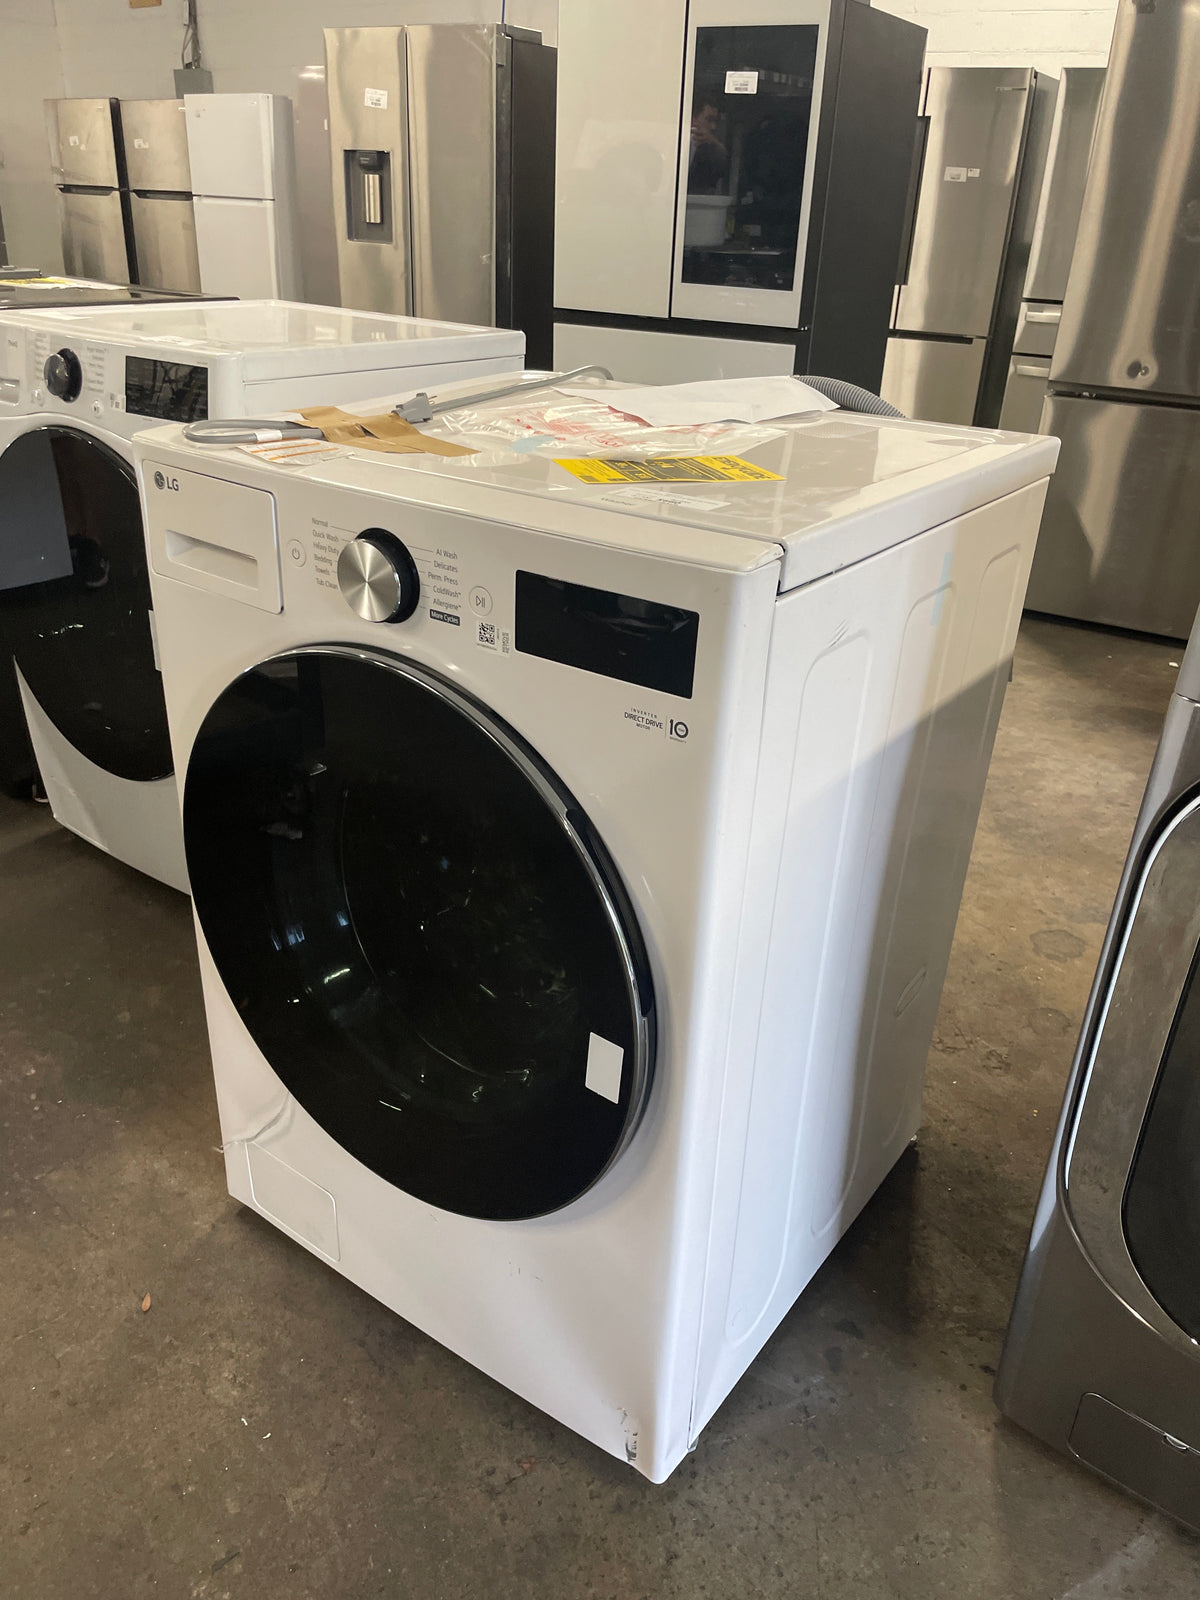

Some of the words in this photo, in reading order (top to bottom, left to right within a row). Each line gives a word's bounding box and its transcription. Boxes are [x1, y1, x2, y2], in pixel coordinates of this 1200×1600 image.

[167, 476, 179, 491] LG
[311, 517, 328, 527] Normal
[312, 529, 325, 539] Quick
[326, 533, 339, 542] Wash
[313, 542, 327, 553] Heavy
[328, 545, 340, 555] Duty
[436, 548, 442, 556] AI
[443, 550, 458, 559] Wash
[314, 554, 333, 566] Bedding
[433, 560, 458, 573] Delicates
[315, 565, 330, 576] Towels
[316, 577, 325, 586] Tub
[325, 580, 339, 590] Clean
[428, 571, 442, 581] Perm.
[443, 575, 459, 585] Press
[431, 610, 443, 620] More
[444, 613, 459, 624] Cycles
[631, 707, 657, 719] INVERTER
[624, 711, 645, 723] DIRECT
[645, 718, 664, 729] DRIVE
[636, 722, 651, 730] MOTOR
[669, 718, 689, 739] 10
